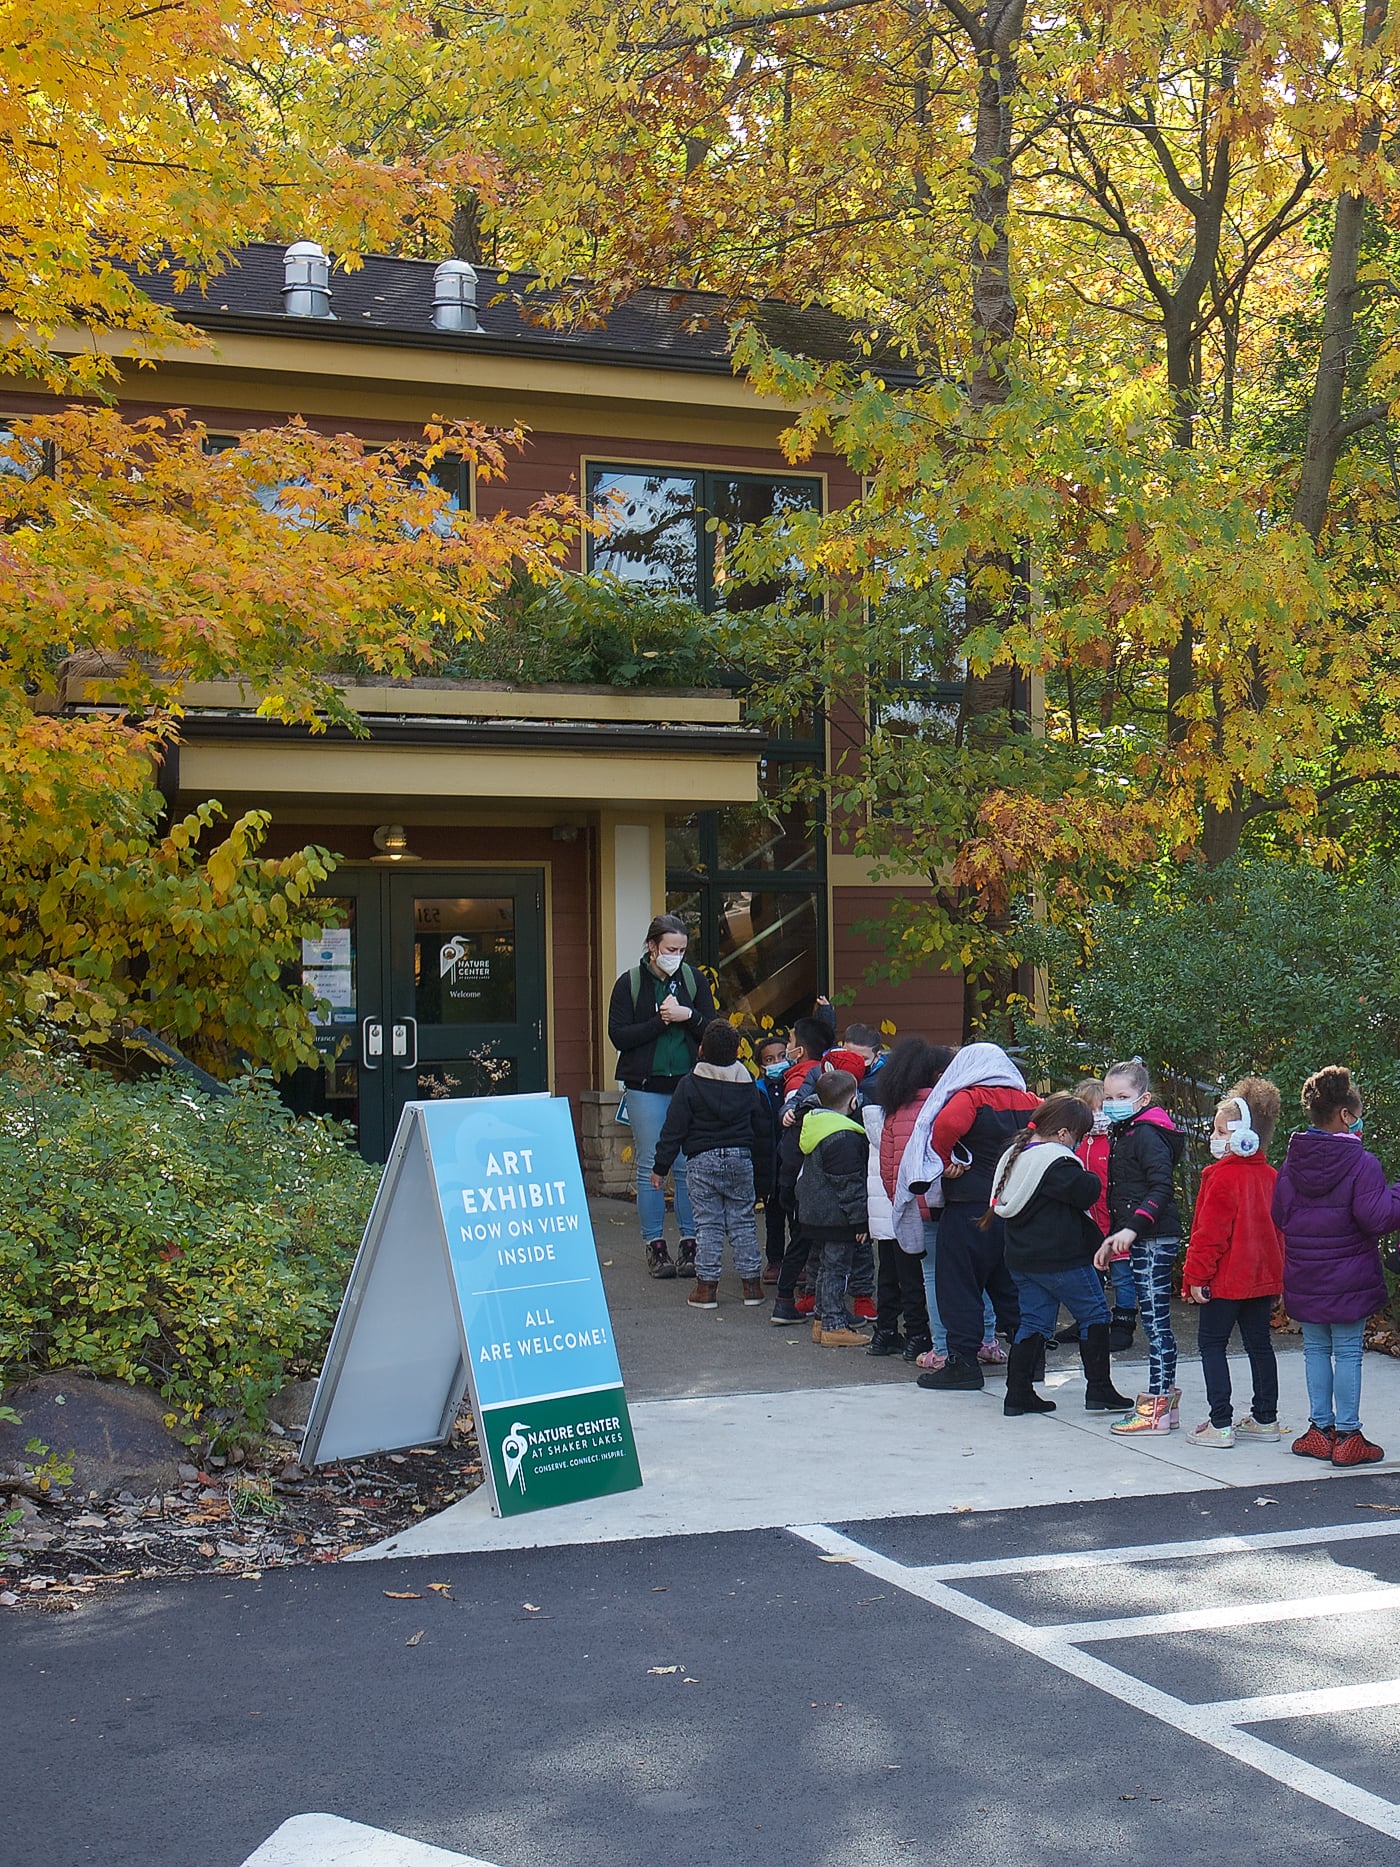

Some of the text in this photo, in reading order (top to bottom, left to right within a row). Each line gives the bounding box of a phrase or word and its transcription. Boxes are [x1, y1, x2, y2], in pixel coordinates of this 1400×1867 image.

[458, 960, 490, 968] NATURE
[458, 968, 490, 976] CENTER
[449, 990, 481, 998] Welcome
[486, 1149, 533, 1177] ART
[461, 1181, 566, 1214] EXHIBIT
[460, 1214, 579, 1242] NOW ON VIEW
[498, 1244, 556, 1266] INSIDE
[525, 1308, 555, 1328] ALL
[479, 1328, 607, 1363] ARE WELCOME!
[527, 1416, 621, 1446] NATURE CENTER
[532, 1432, 623, 1459] AT SHAKER LAKES
[534, 1449, 626, 1475] CONSERVE. CONNECT. INSPIRE.
